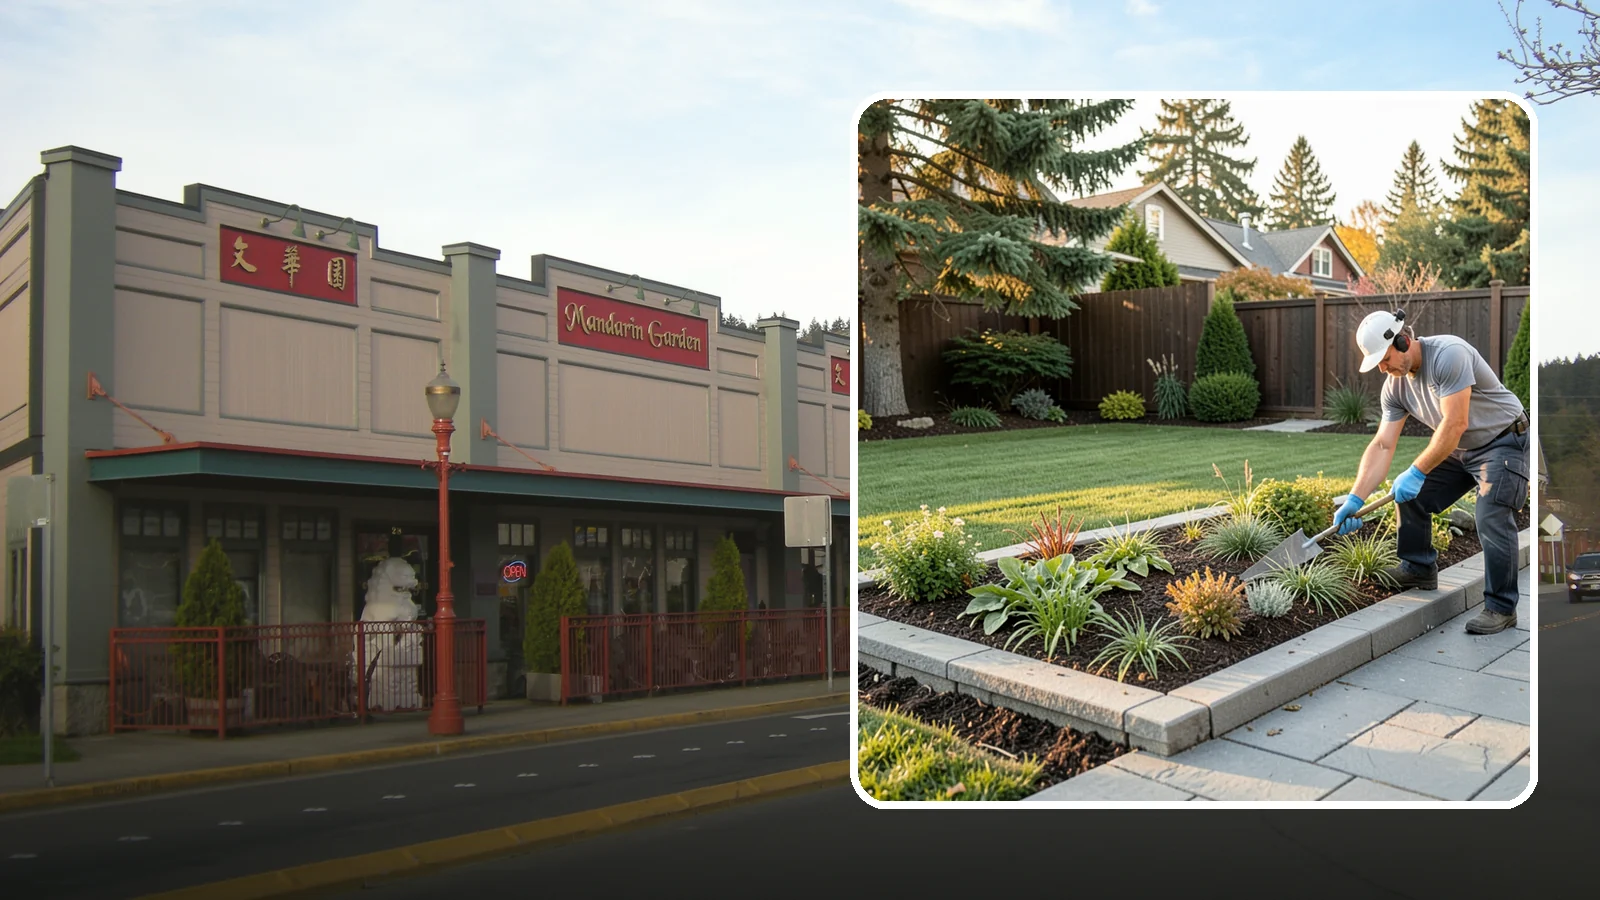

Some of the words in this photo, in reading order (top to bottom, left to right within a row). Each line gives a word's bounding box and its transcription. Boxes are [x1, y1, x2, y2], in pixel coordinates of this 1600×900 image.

[231, 236, 346, 291] 文華園
[564, 302, 643, 341] Mandarin
[648, 320, 701, 352] Garden
[503, 566, 527, 578] OPEN
